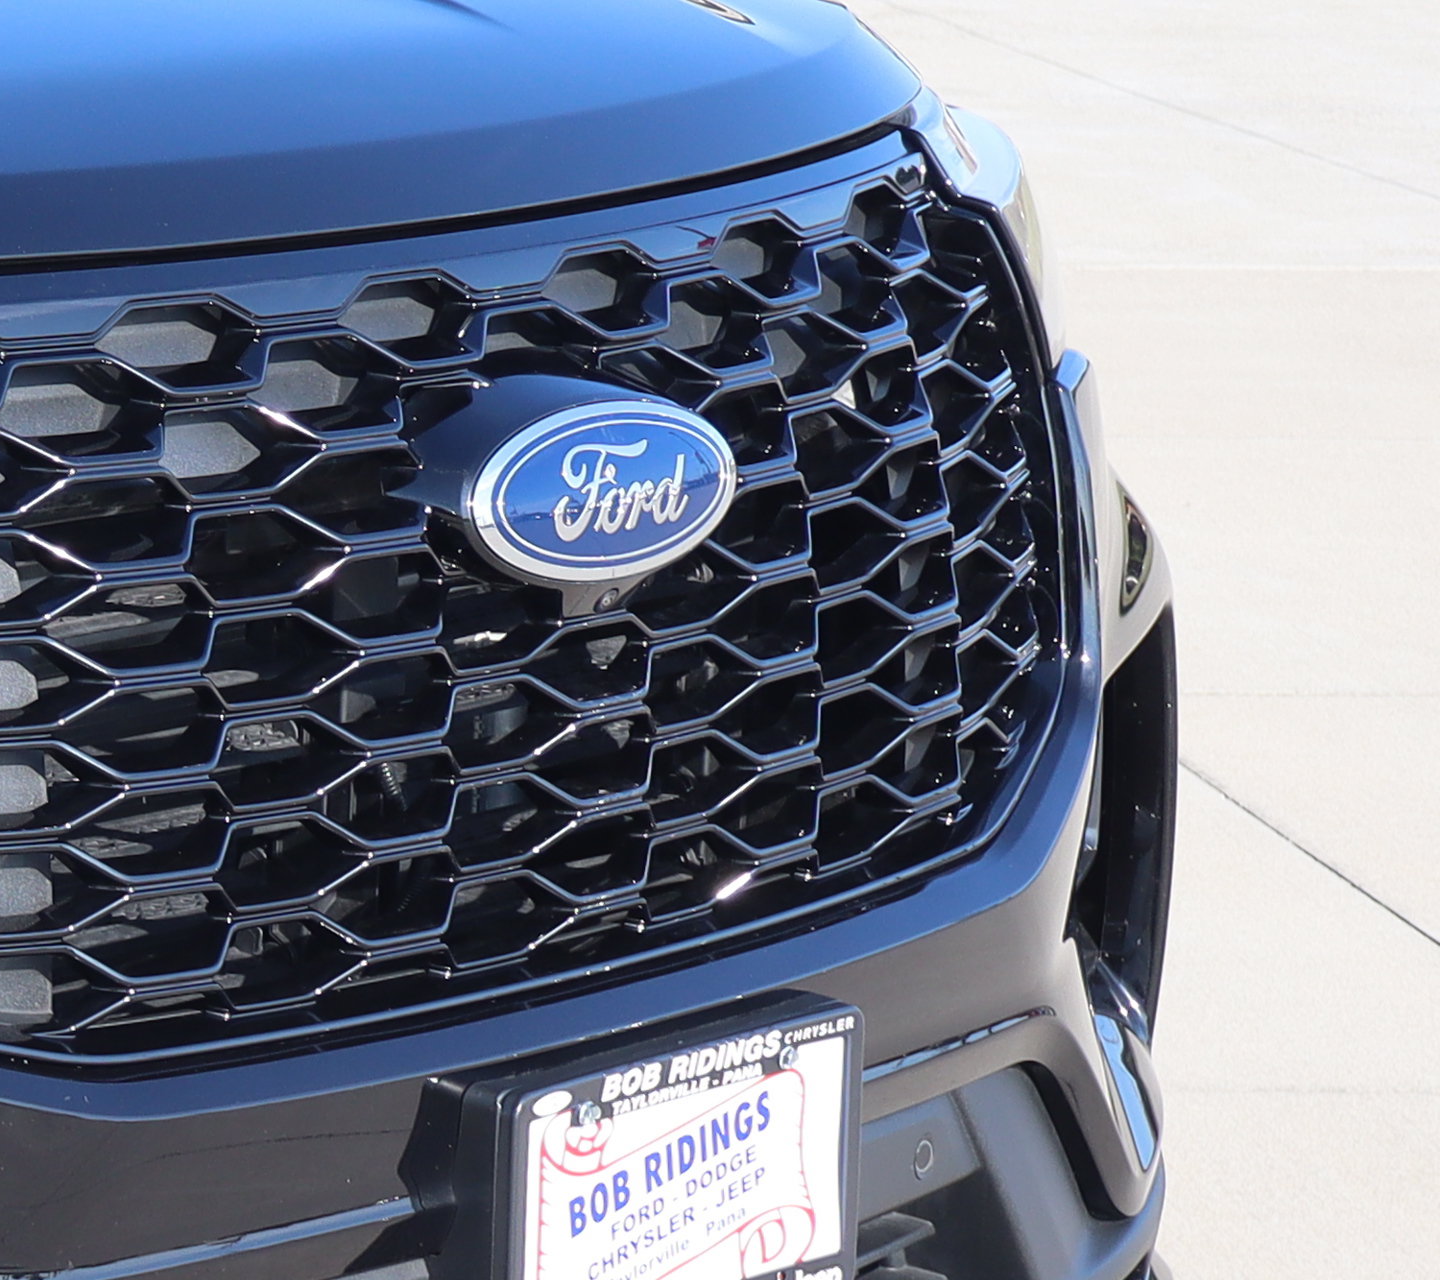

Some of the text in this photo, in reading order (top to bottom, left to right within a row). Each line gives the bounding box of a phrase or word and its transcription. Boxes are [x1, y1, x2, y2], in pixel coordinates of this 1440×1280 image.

[553, 438, 690, 543] Ford
[600, 1016, 855, 1103] BOB RIDINGS CHRYSLER
[611, 1076, 710, 1116] TAYLORVILLE
[721, 1062, 764, 1087] PANA
[568, 1090, 771, 1239] BOB RIDINGS
[611, 1197, 665, 1241] FORD
[685, 1144, 757, 1198] DODGE
[588, 1206, 695, 1280] CHRYSLER
[716, 1167, 766, 1208] JEEP
[705, 1207, 747, 1237] Pana
